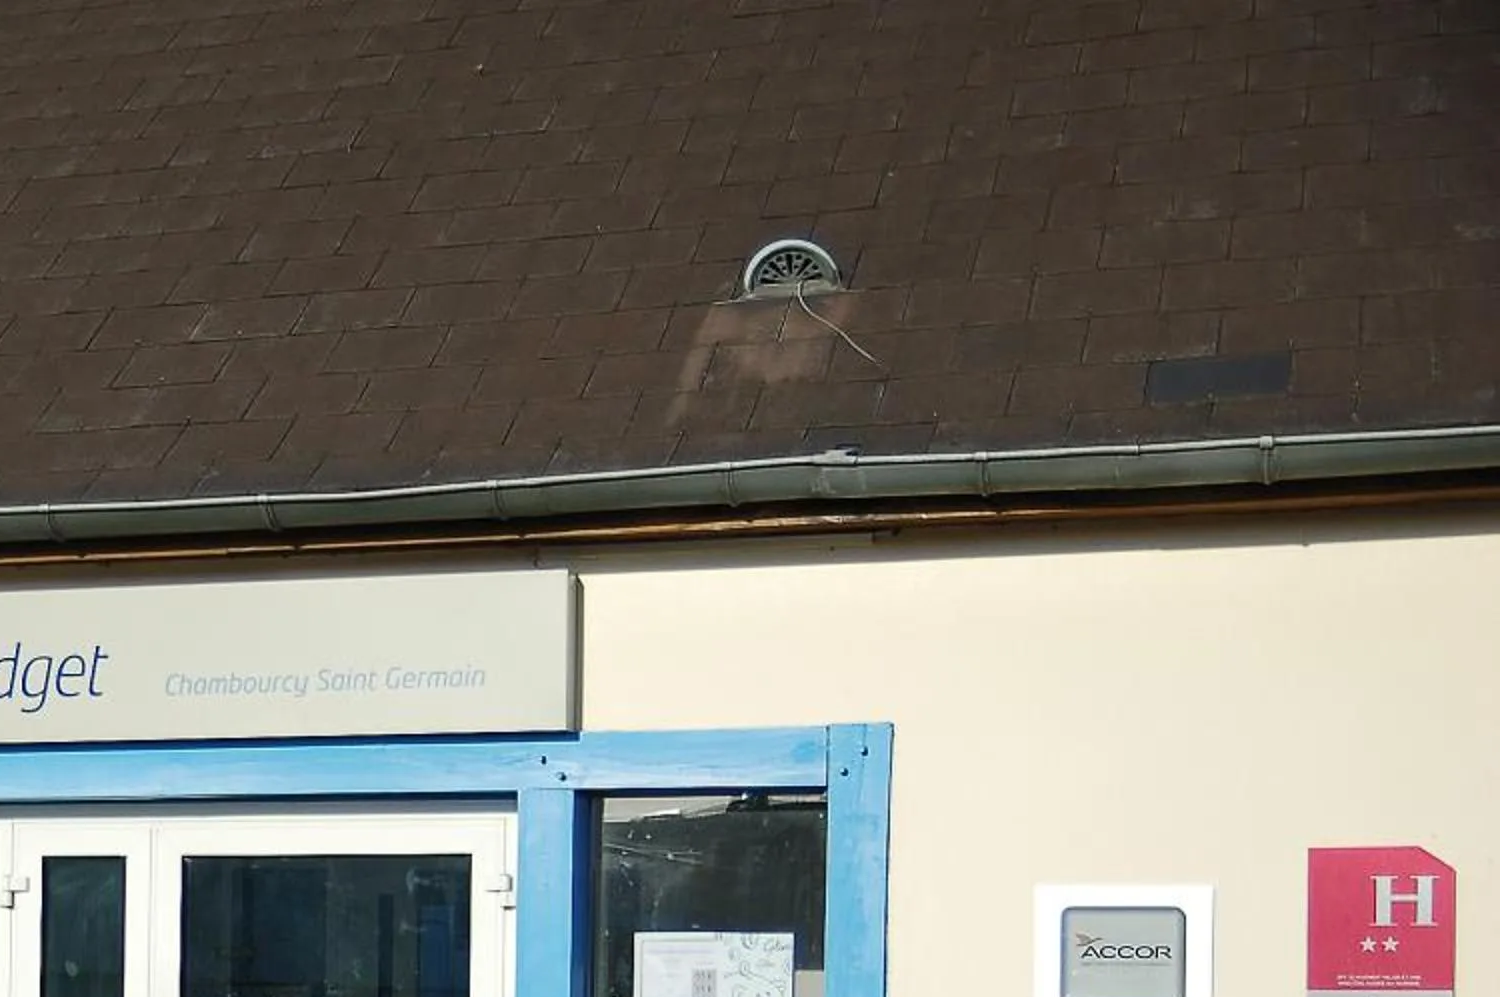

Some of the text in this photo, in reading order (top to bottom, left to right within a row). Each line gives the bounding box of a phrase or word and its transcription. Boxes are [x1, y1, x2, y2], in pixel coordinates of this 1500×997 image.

[165, 664, 486, 697] Chambourcy Saint Germain
[1369, 874, 1440, 927] H
[1081, 945, 1172, 959] ACCOR
